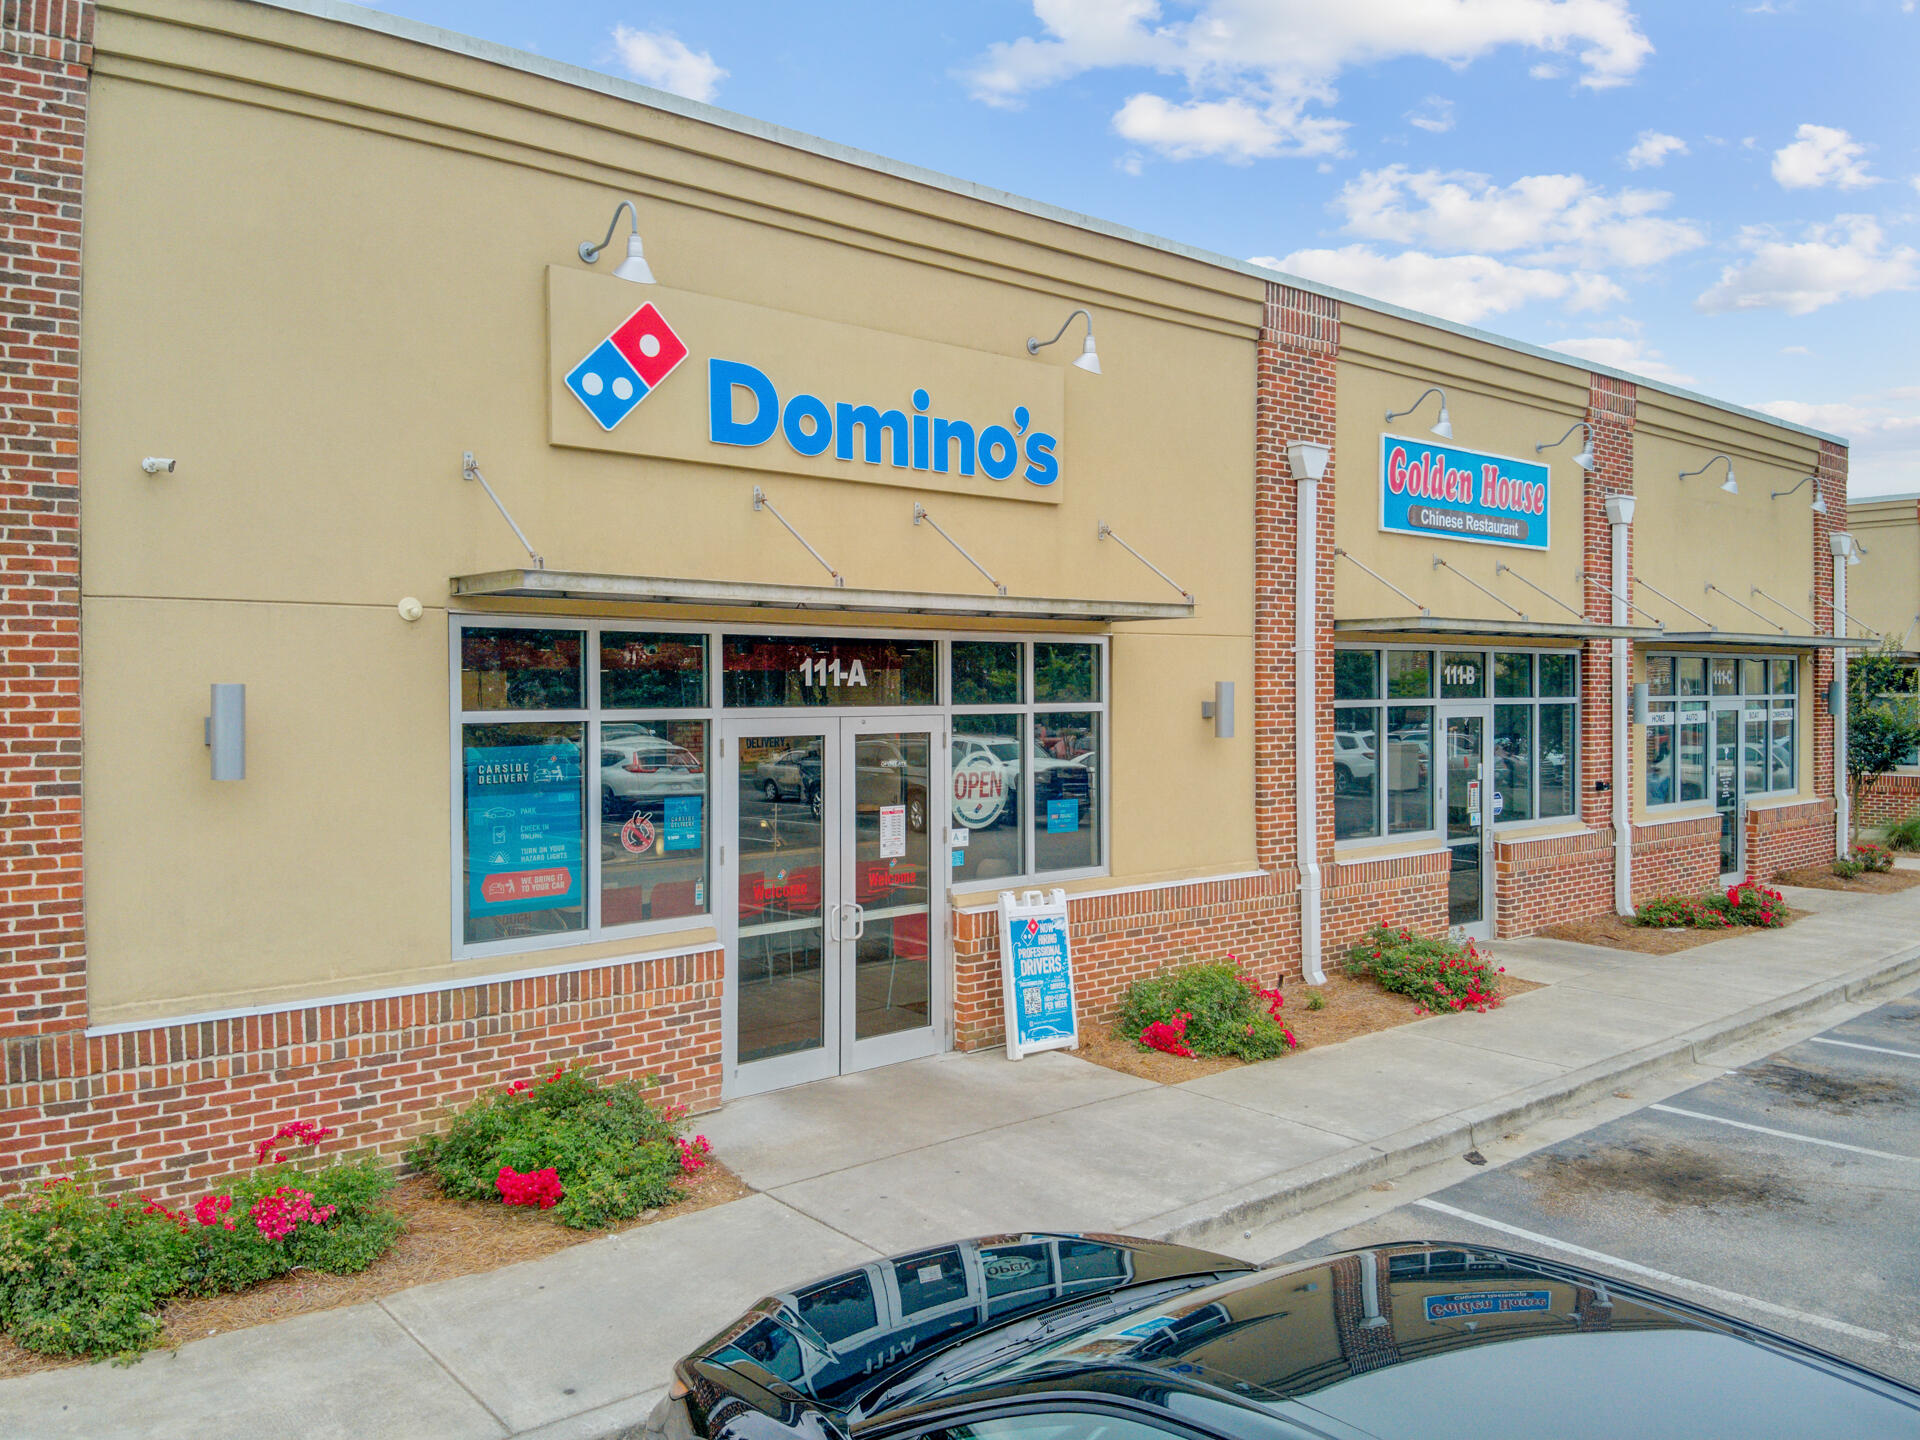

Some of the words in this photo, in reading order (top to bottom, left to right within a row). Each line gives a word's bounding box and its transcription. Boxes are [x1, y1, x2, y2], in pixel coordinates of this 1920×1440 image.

[708, 358, 1060, 486] Domino's
[1388, 446, 1473, 504] Golden
[1480, 463, 1546, 515] House
[1420, 509, 1463, 529] Chinese
[1465, 515, 1519, 537] Restaurant
[799, 658, 868, 686] 111-A
[1444, 665, 1475, 685] 111-B
[1712, 669, 1733, 685] 111-C
[1651, 714, 1666, 723] HOME
[1685, 713, 1698, 721] AUTO
[745, 737, 786, 749] DELIVERY
[478, 762, 529, 774] CARSIDE
[478, 773, 529, 785] DELIVERY
[954, 771, 1002, 800] OPEN
[520, 807, 537, 816] PARK
[520, 824, 540, 833] CHECK
[542, 823, 550, 831] IN
[520, 847, 538, 855] TURN
[546, 852, 568, 861] LIGHTS
[521, 877, 533, 885] WE
[534, 874, 556, 883] BRING
[556, 873, 564, 881] IT
[867, 870, 917, 888] Welcome
[521, 885, 530, 893] TO
[531, 882, 549, 892] YOUR
[551, 881, 565, 890] CAR
[752, 882, 808, 900] Welcome
[1018, 944, 1062, 960] PROFESSIONAL
[1020, 956, 1062, 977] DRIVERS
